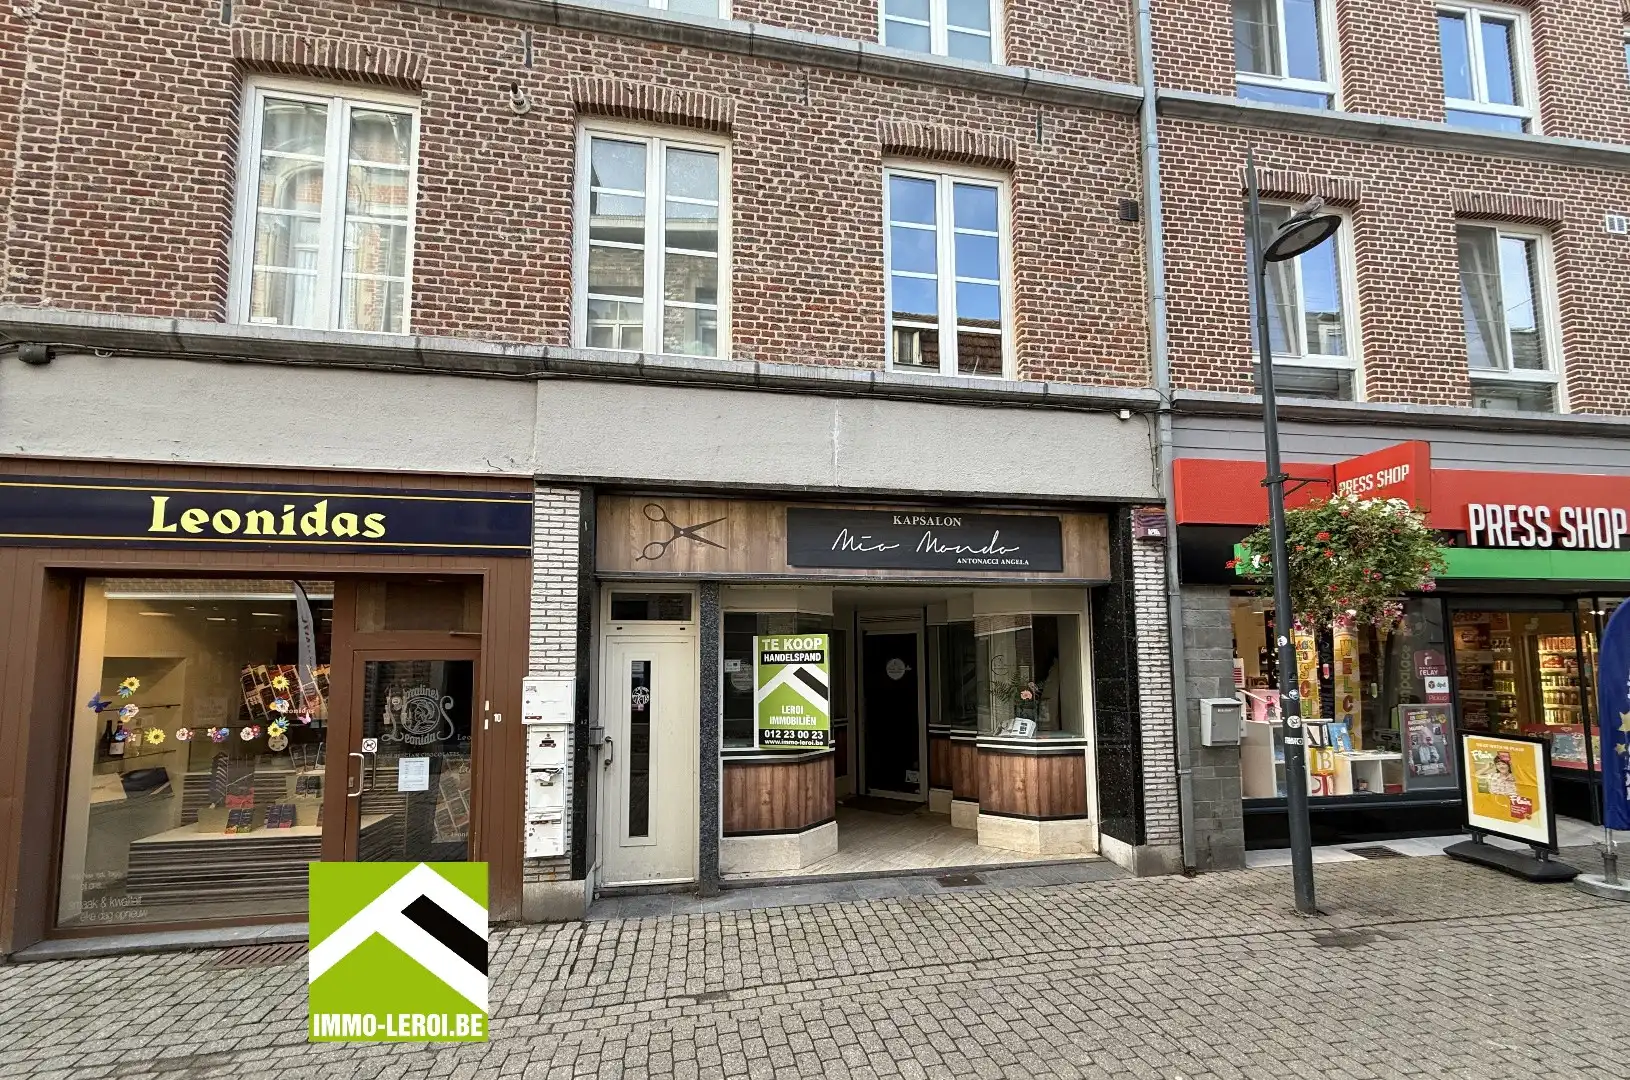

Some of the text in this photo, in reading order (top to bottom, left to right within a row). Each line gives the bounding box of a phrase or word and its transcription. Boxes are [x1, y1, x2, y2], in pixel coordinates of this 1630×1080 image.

[1338, 464, 1410, 495] PRESS SHOP
[147, 495, 387, 539] Leonidas
[892, 515, 962, 527] KAPSALON
[1467, 503, 1628, 549] PRESS SHOP
[831, 528, 1020, 555] Mio Mondo
[956, 557, 1030, 566] ANTONACCI ANGELA
[761, 637, 823, 651] TE KOOP
[763, 652, 822, 663] HANDELSPAND
[781, 705, 804, 714] LEROI
[769, 715, 817, 726] IMMOBILIËN
[764, 730, 824, 739] 012 23 00 23
[1510, 795, 1532, 806] Flair
